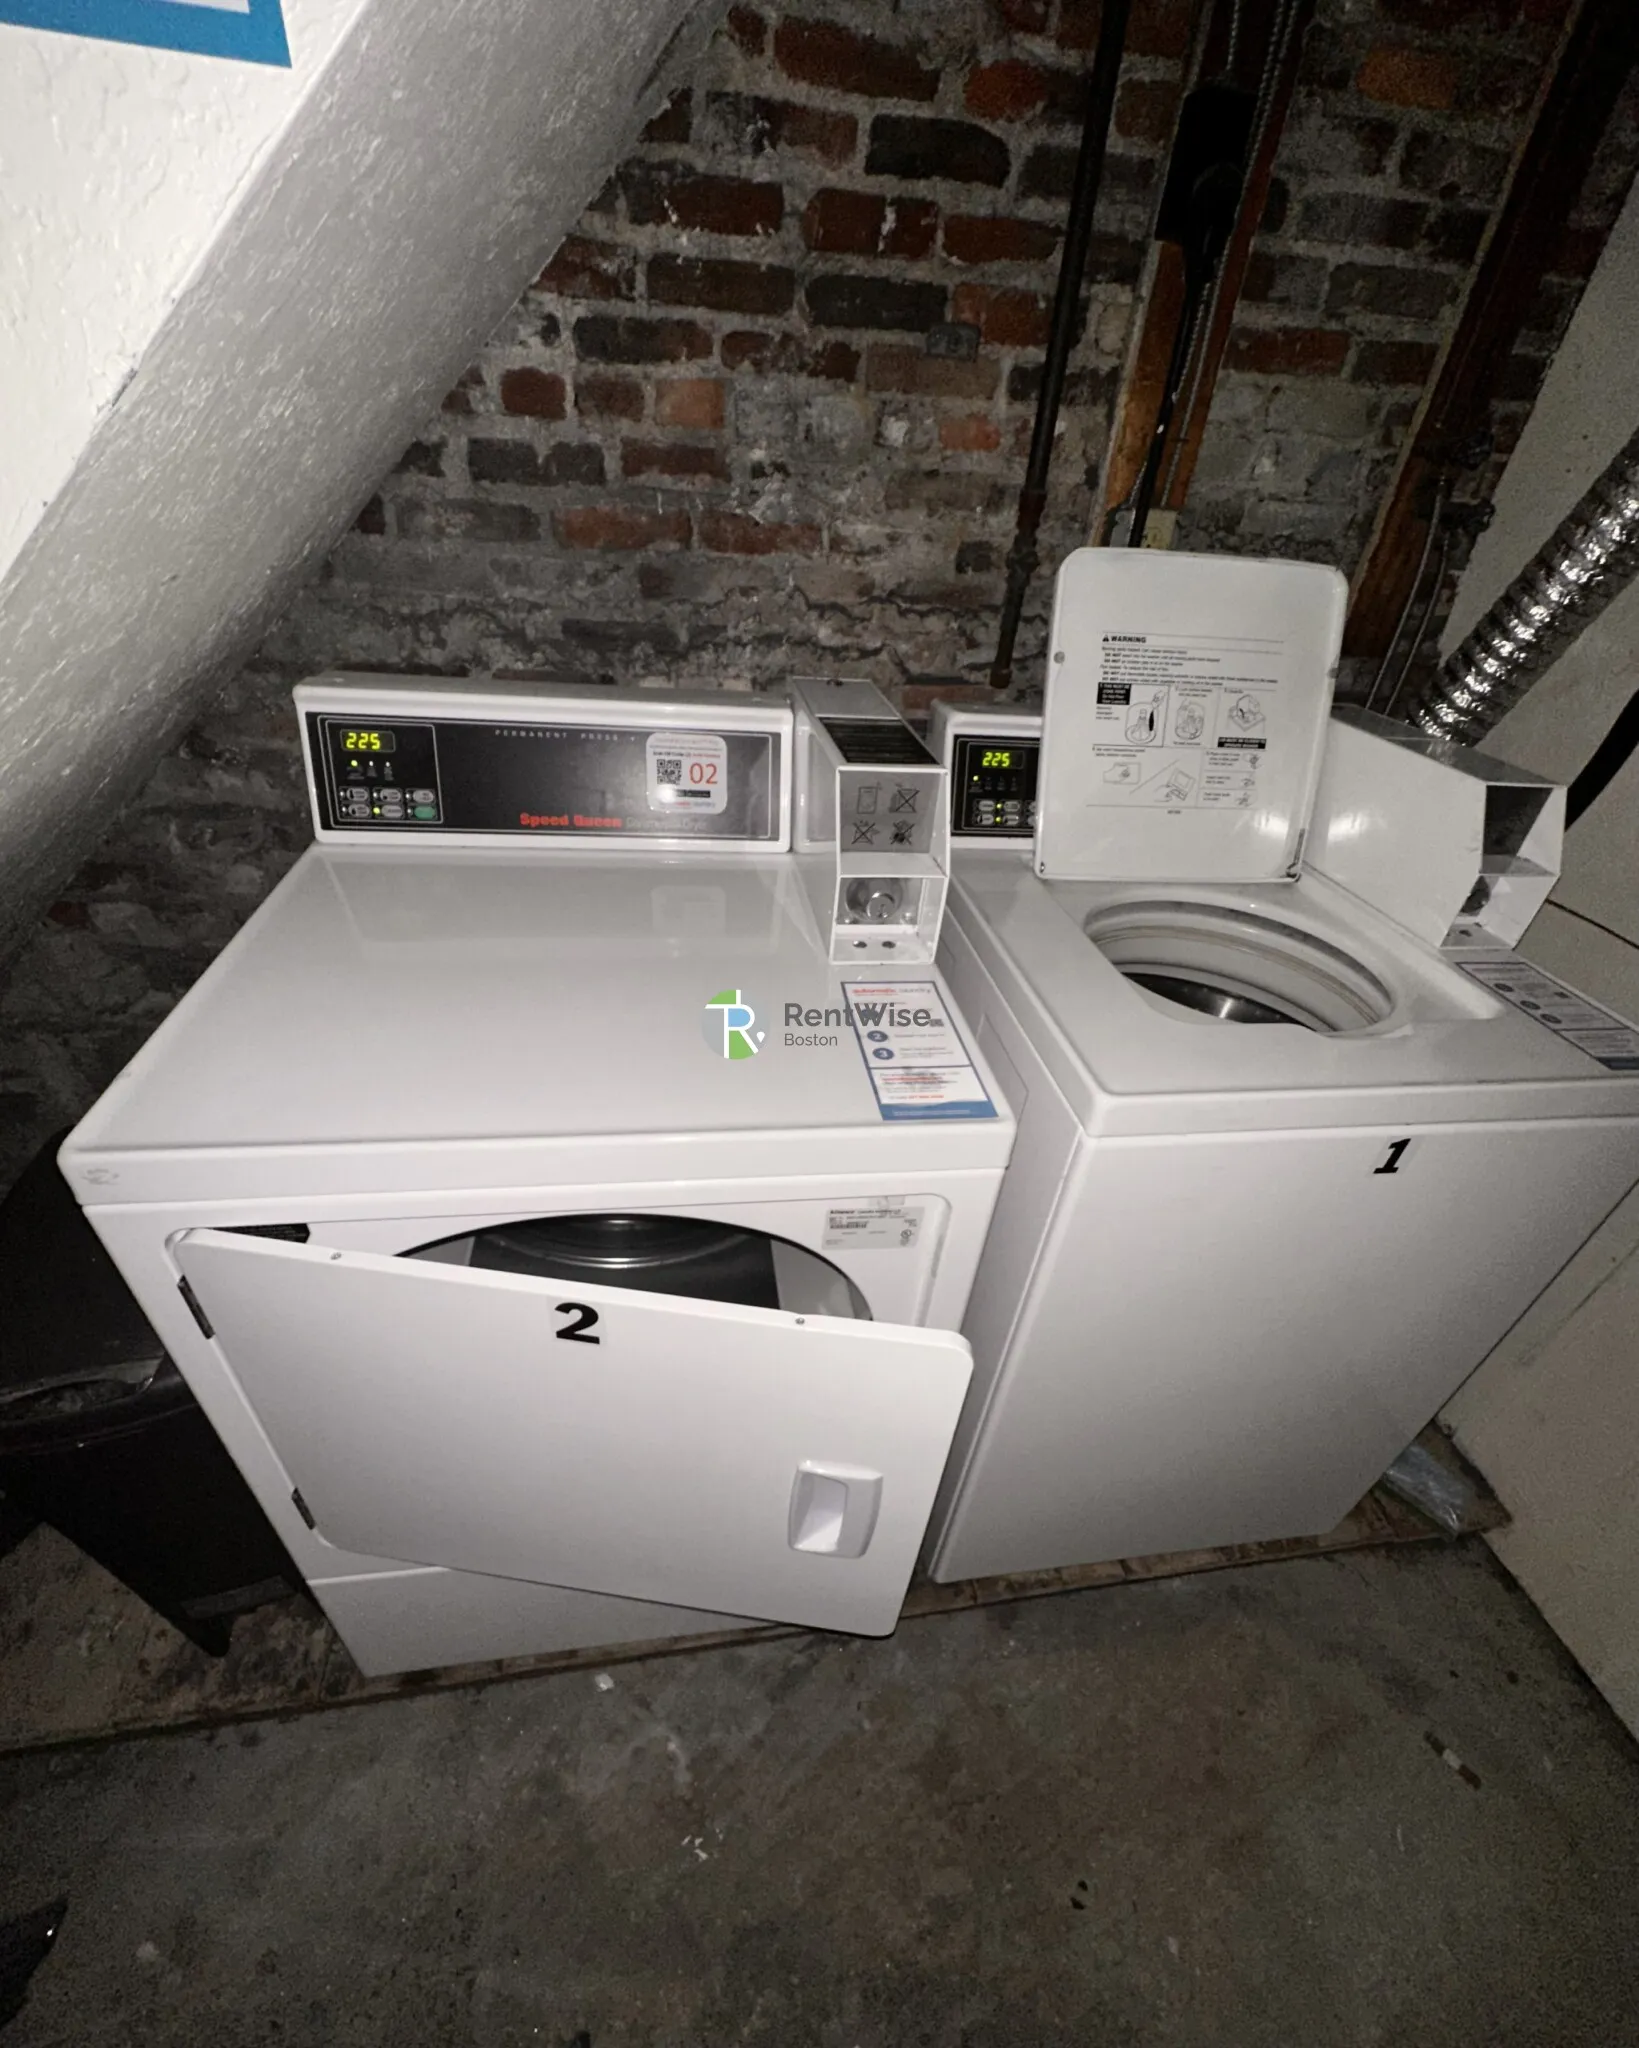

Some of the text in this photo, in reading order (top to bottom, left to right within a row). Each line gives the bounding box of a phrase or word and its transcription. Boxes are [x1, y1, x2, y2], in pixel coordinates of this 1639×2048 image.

[346, 732, 381, 750] 225
[495, 729, 618, 741] PERMANENT PRESS
[982, 752, 1010, 767] 225
[689, 762, 718, 784] 02
[520, 811, 569, 828] Speed
[573, 813, 623, 828] Queen
[1373, 1138, 1411, 1174] 1
[554, 1302, 600, 1344] 2
